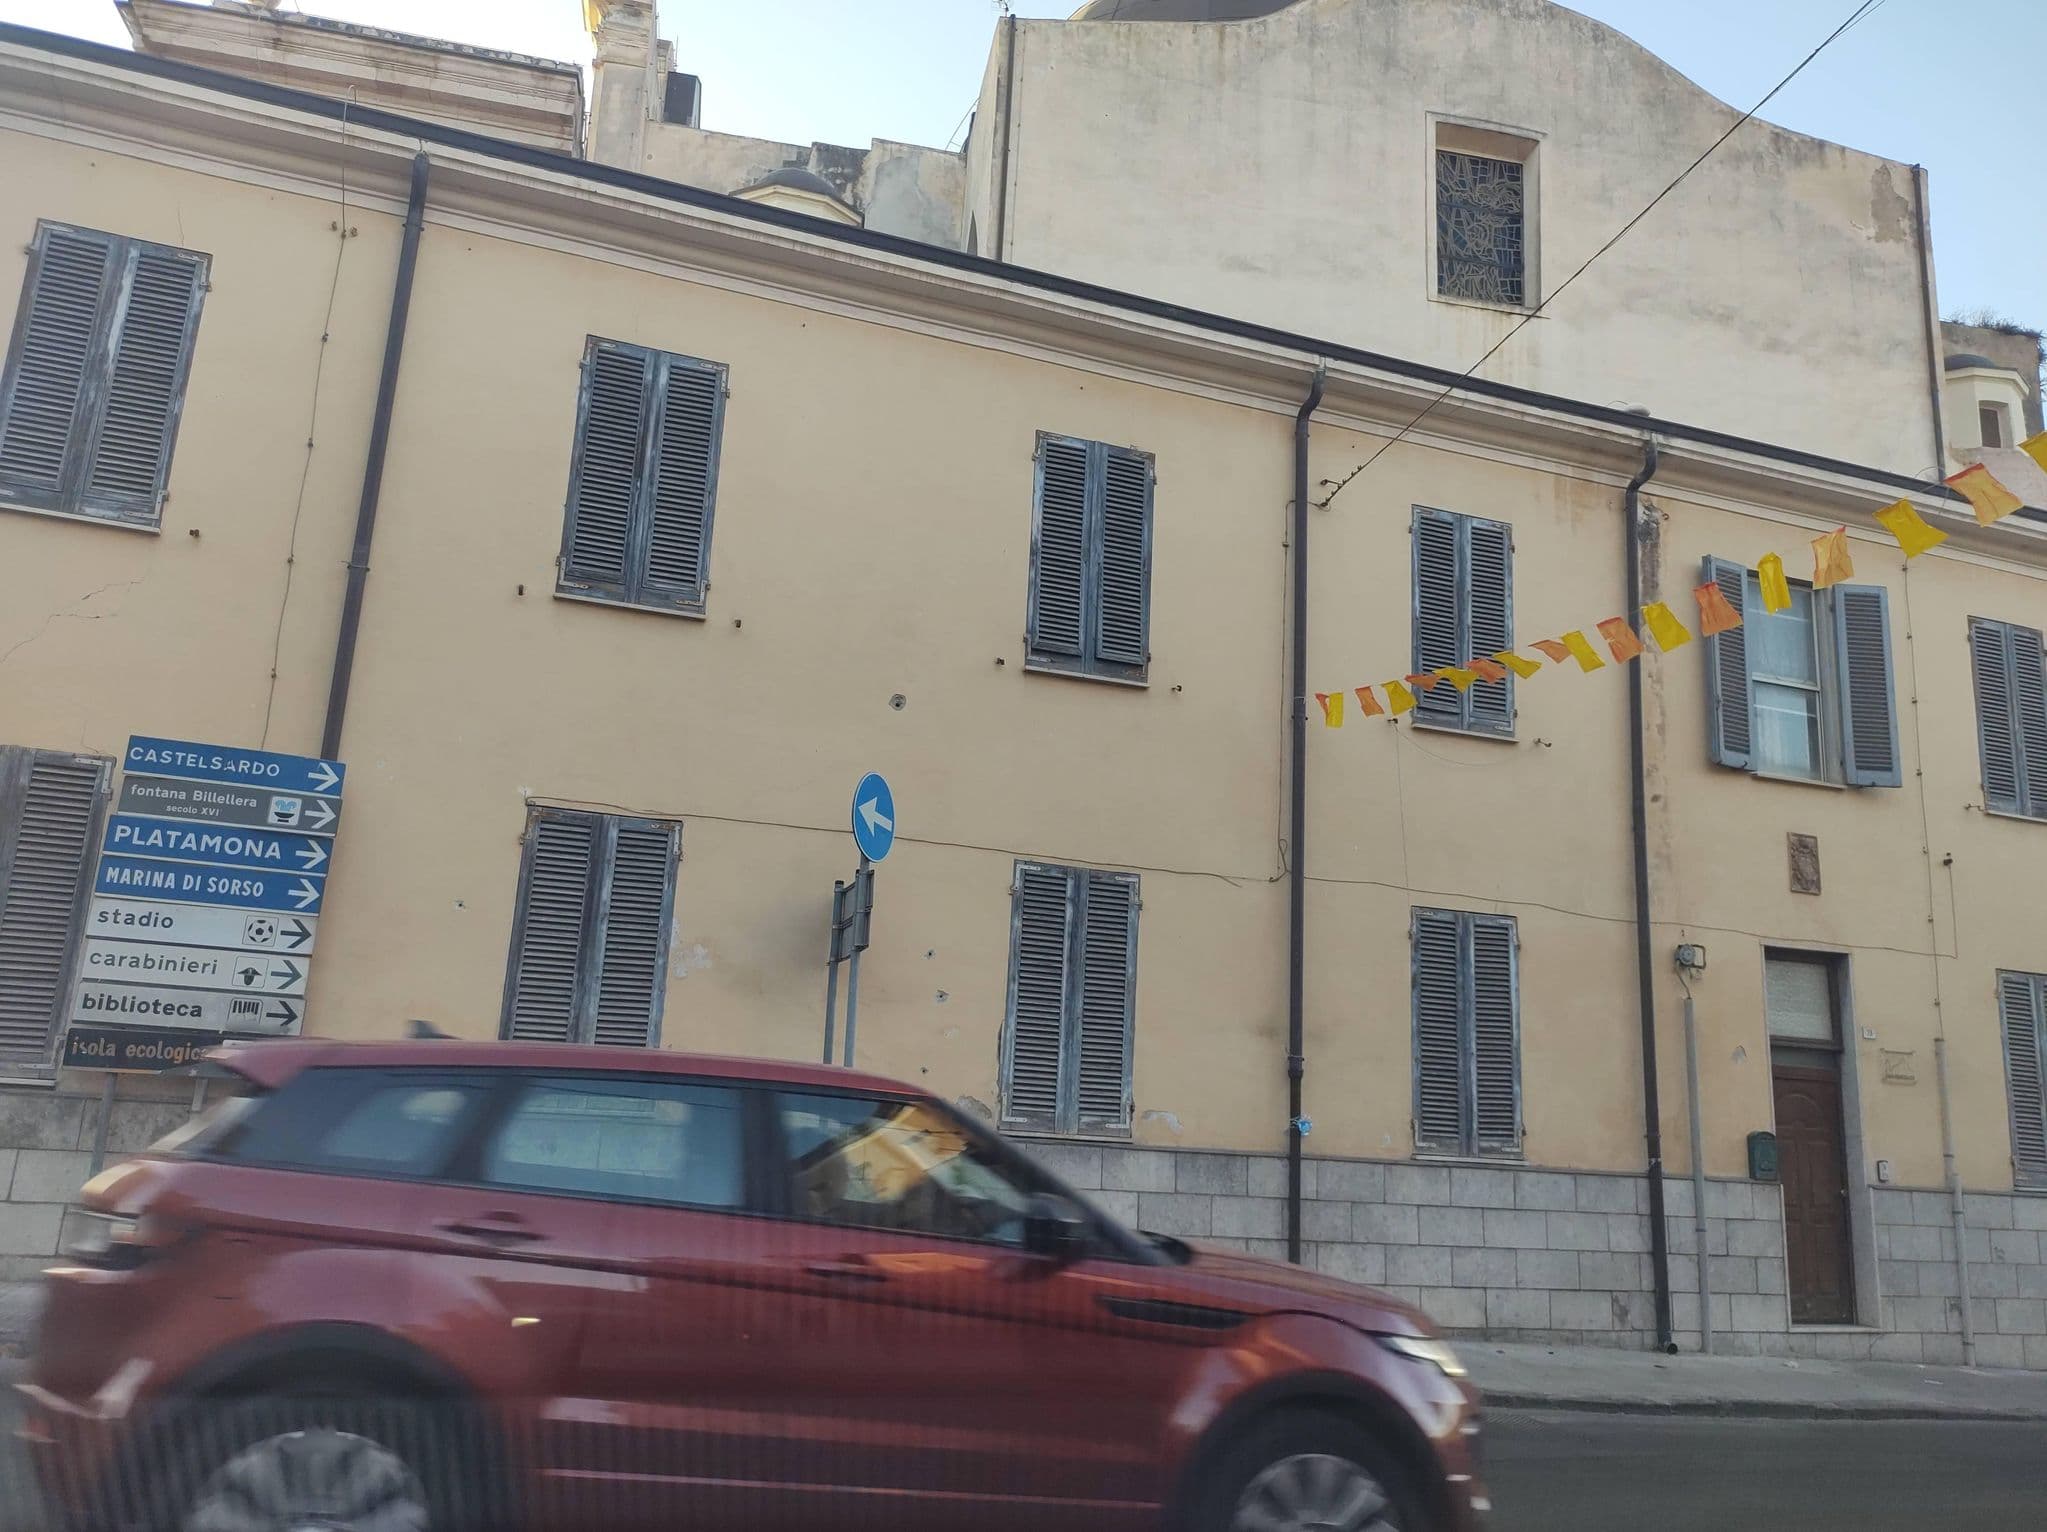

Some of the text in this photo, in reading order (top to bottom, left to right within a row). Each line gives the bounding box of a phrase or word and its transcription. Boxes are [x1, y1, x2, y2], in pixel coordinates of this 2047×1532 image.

[131, 747, 280, 777] CASTELSARDO
[130, 784, 257, 807] fontana Billellera
[166, 803, 220, 817] secolo XVI
[115, 825, 281, 859] PLATAMONA
[106, 866, 263, 897] MARINA DI SORSO
[98, 909, 174, 928] stadio
[90, 952, 218, 974] carabinieri
[82, 993, 203, 1017] biblioteca
[72, 1037, 116, 1056] isola
